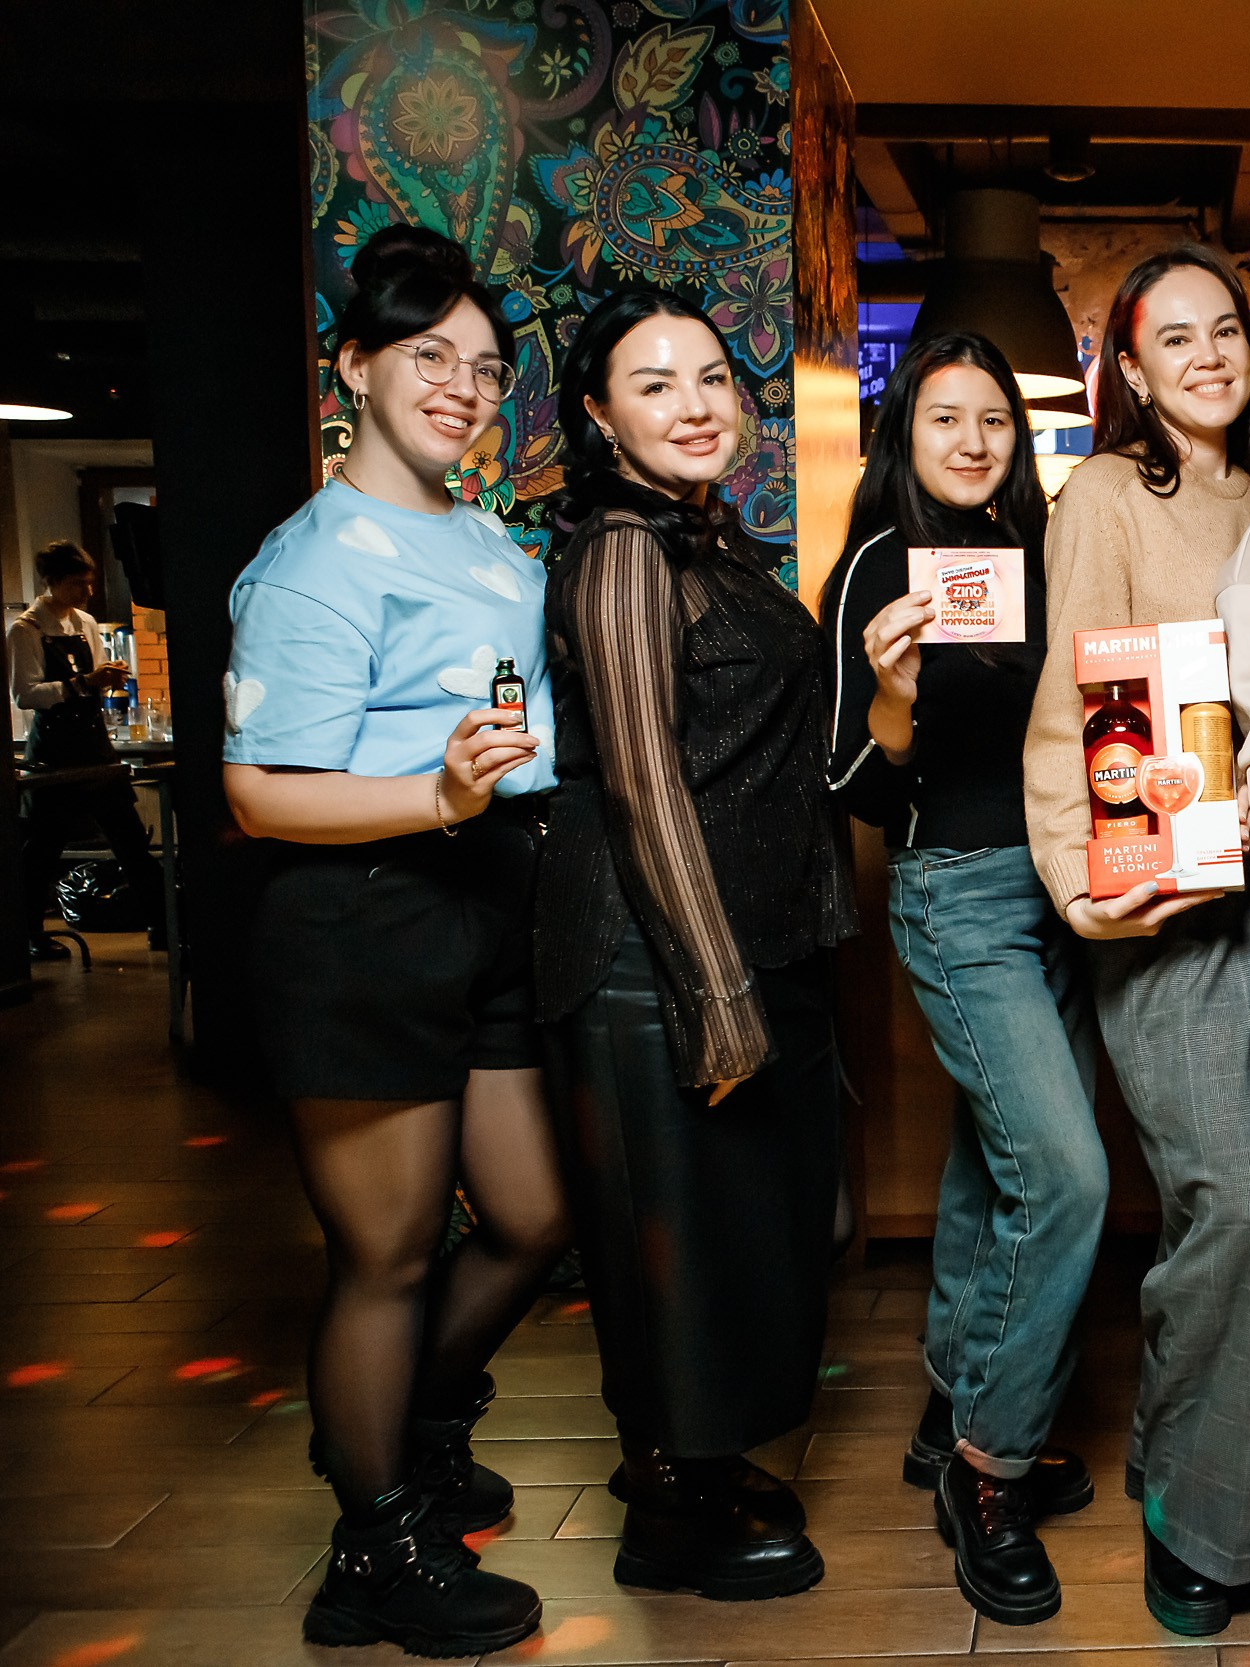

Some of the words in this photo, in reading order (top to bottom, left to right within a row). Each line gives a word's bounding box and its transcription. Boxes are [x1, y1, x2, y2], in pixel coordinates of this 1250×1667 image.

[952, 585, 983, 598] QUIZ
[1084, 636, 1157, 656] MARTINI
[1095, 767, 1137, 782] MARTIN
[1157, 778, 1182, 786] MARTINI
[1107, 820, 1136, 829] FIERO
[1103, 843, 1157, 856] MARTINI
[1104, 854, 1144, 865] FIERO
